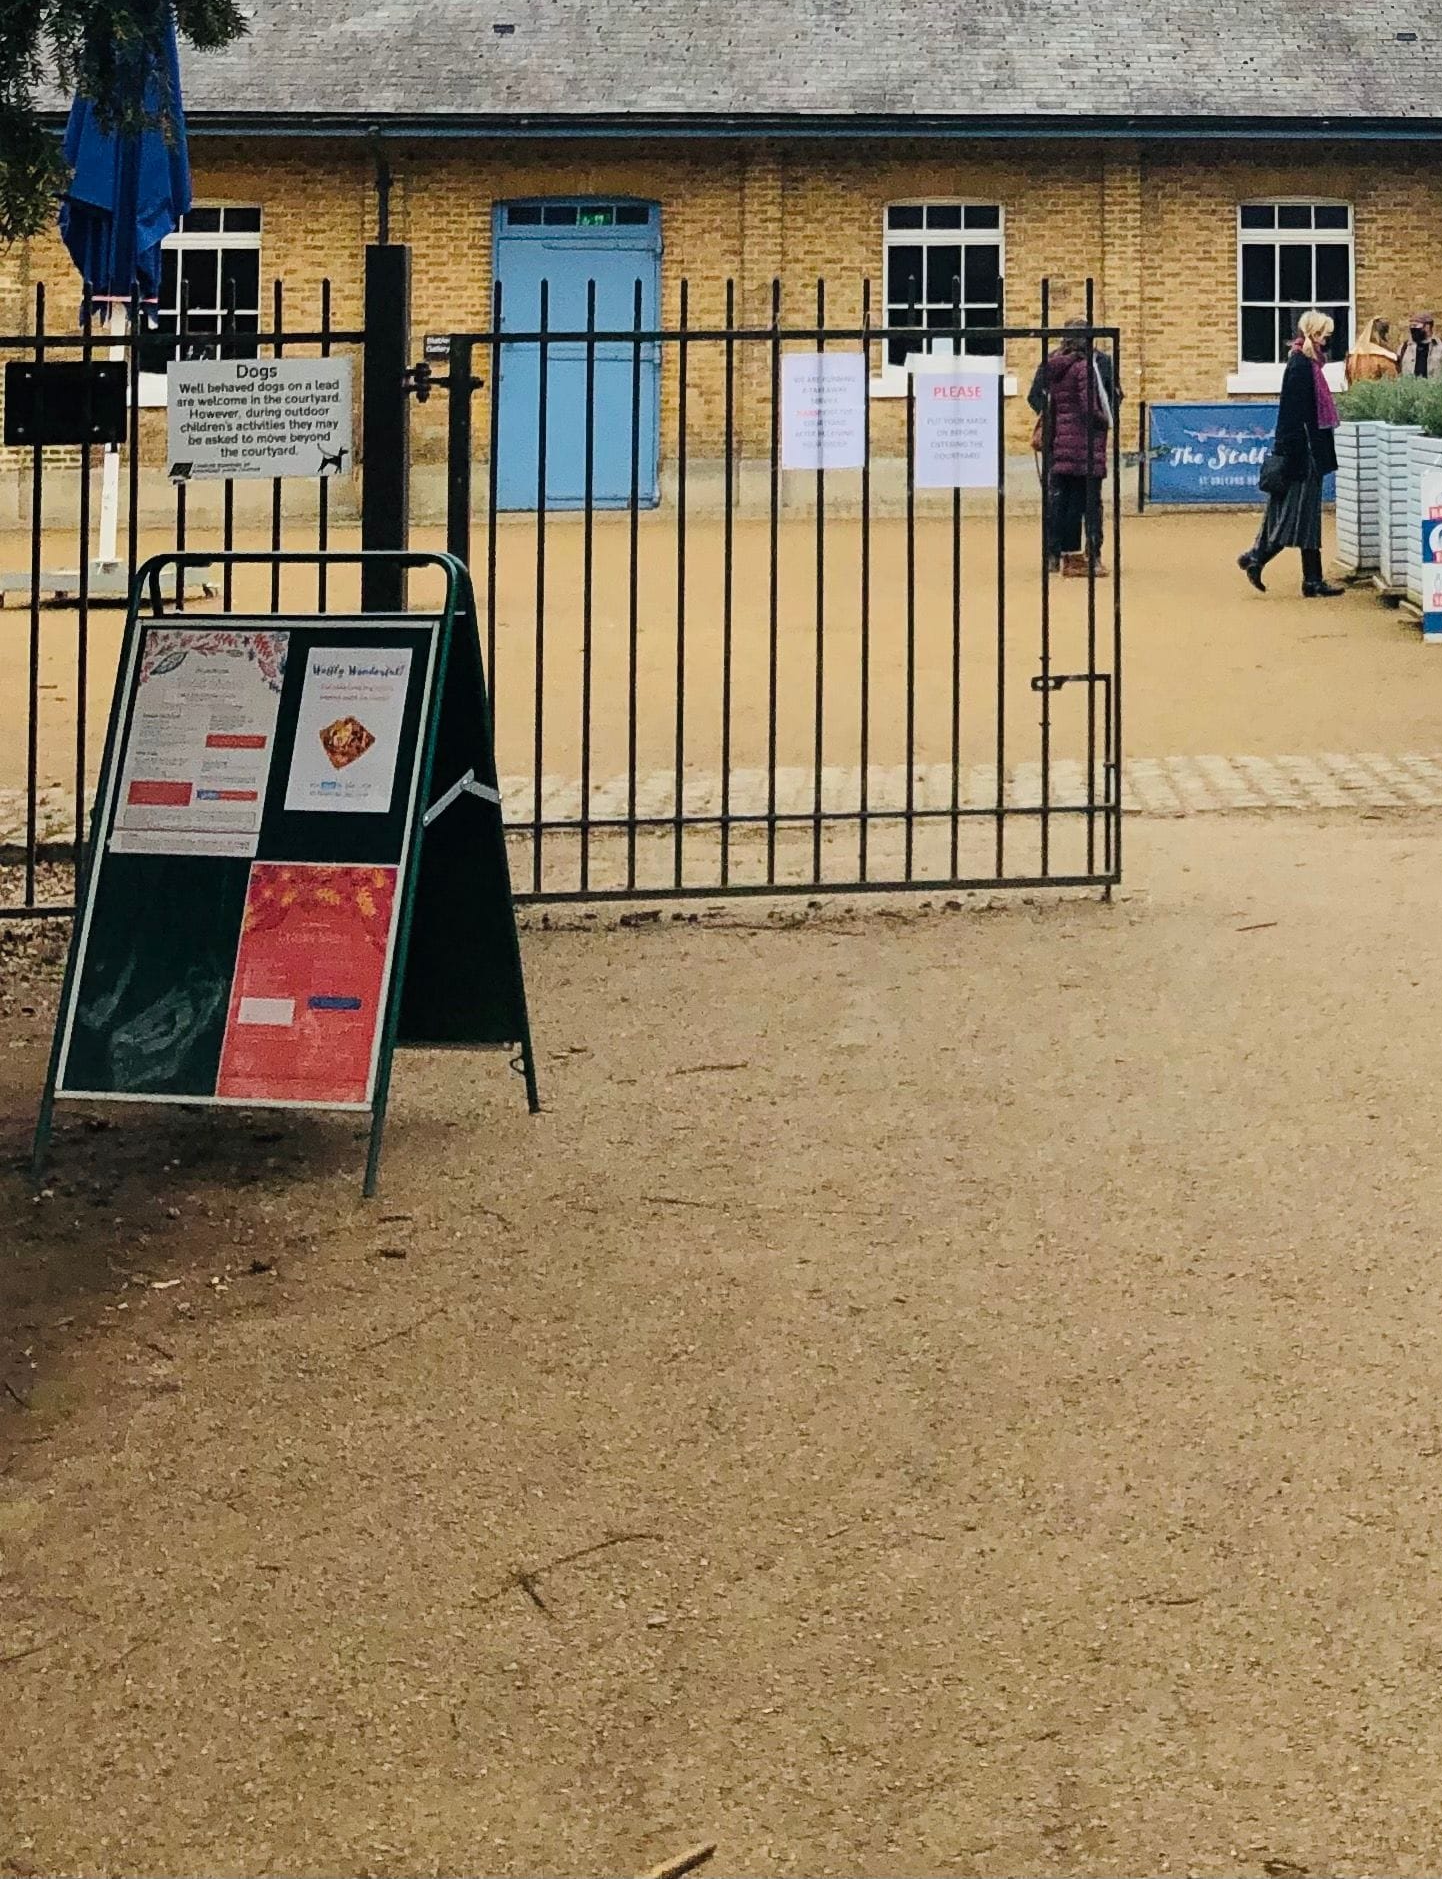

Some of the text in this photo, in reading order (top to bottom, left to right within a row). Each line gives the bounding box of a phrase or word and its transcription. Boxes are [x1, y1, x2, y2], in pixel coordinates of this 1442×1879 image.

[236, 364, 278, 380] Dogs
[178, 379, 340, 394] Well behaved dogs on a lead
[933, 385, 982, 399] PLEASE
[176, 392, 342, 407] are welcome in the courtyard.
[245, 406, 282, 418] during
[285, 405, 330, 417] outdoor
[180, 419, 339, 433] children's activities they may
[188, 432, 331, 445] be asked to move beyond
[220, 445, 299, 457] the courtyard.
[1170, 445, 1205, 467] The
